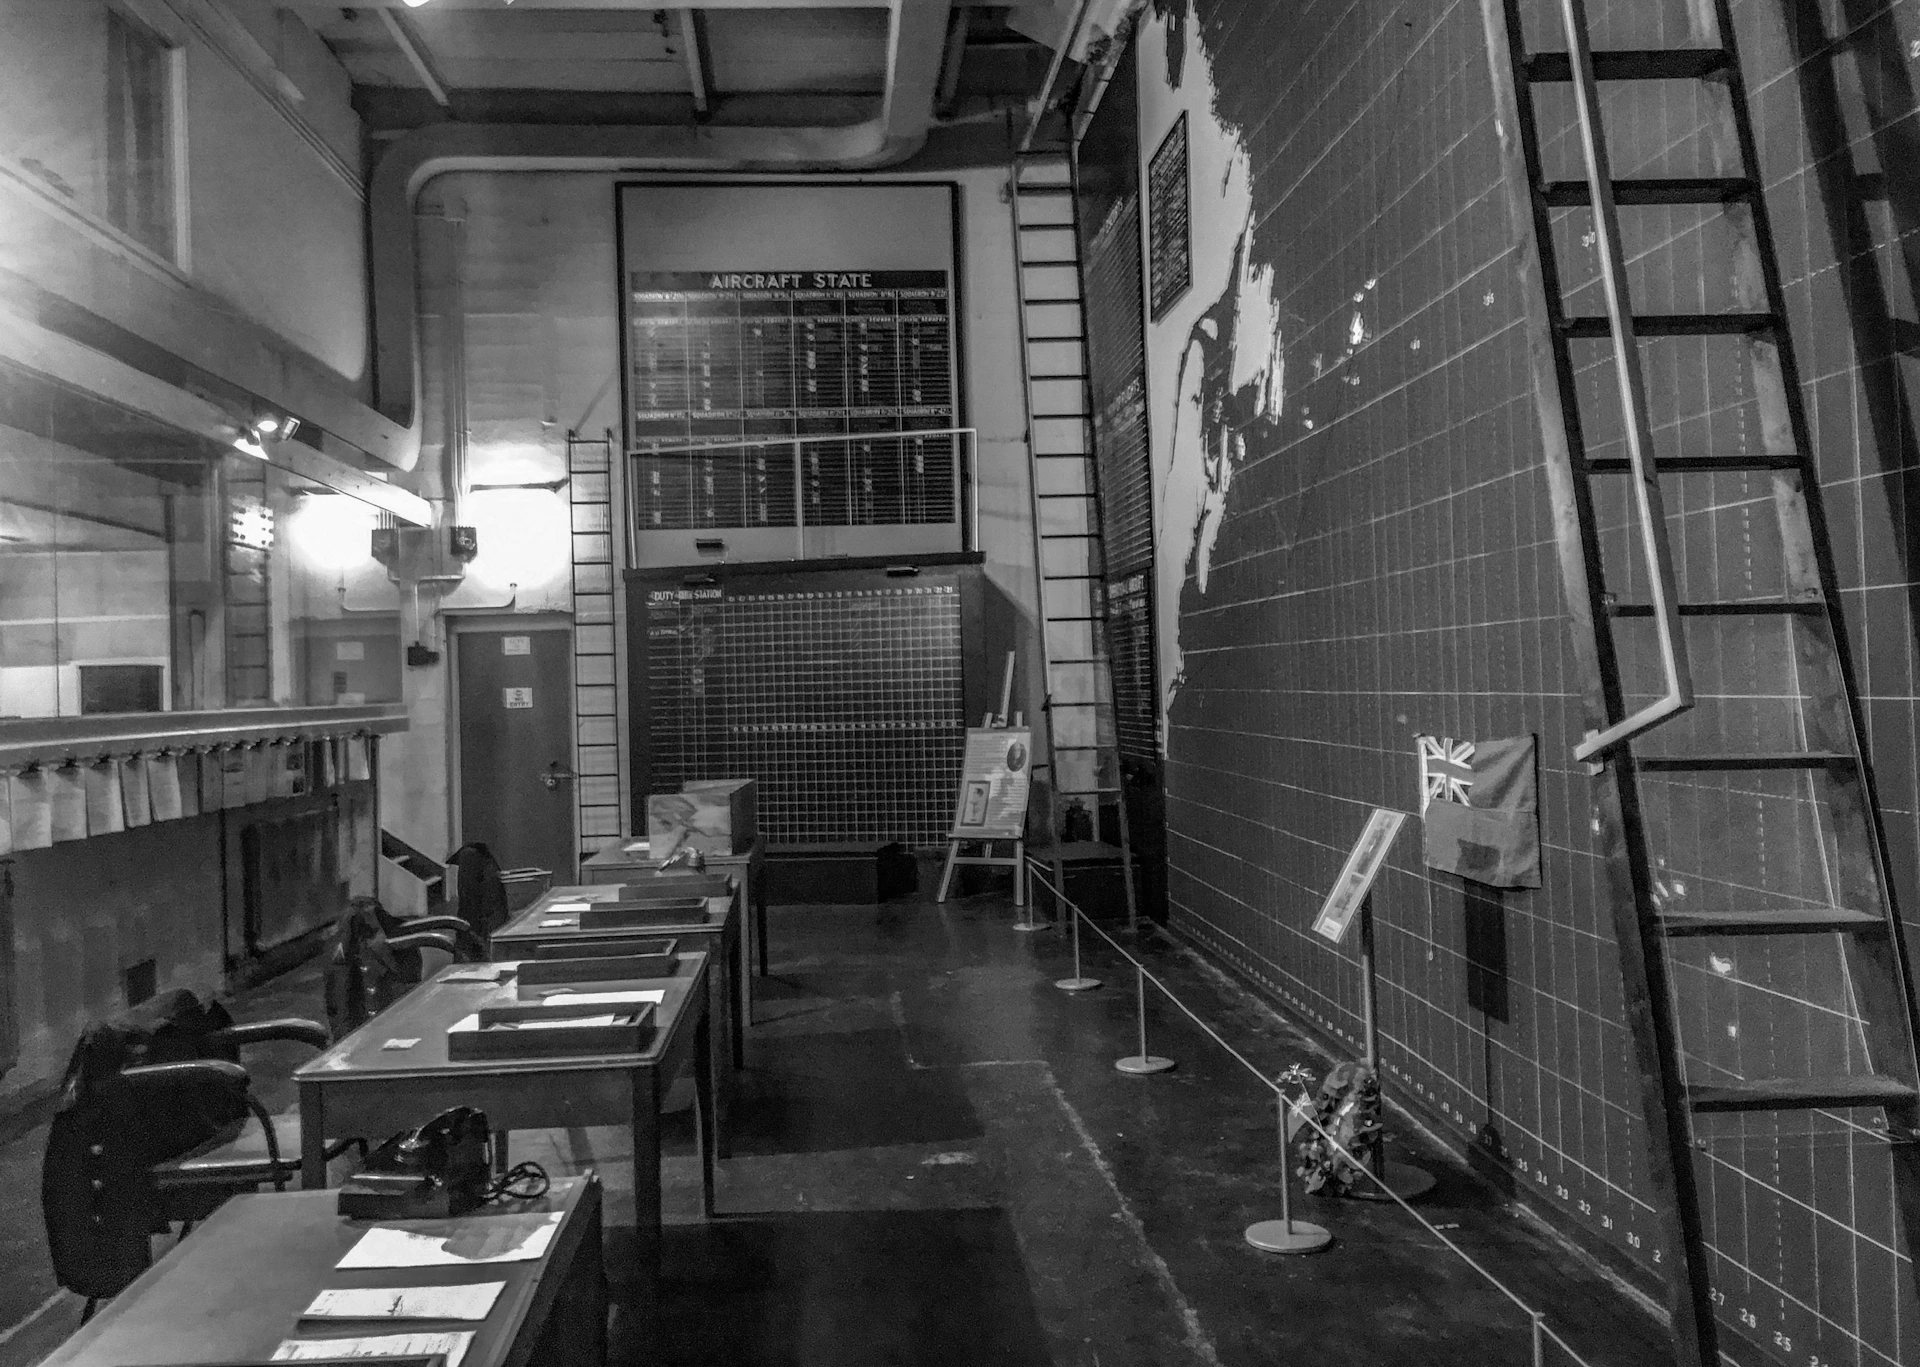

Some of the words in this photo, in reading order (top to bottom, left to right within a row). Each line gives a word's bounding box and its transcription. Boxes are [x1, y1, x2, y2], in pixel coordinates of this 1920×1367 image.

[710, 273, 803, 289] AIRCRAFT
[814, 272, 872, 289] STATE
[652, 590, 675, 601] DUTY
[693, 589, 722, 600] STATION
[1601, 1214, 1613, 1231] 31
[1626, 1231, 1641, 1249] 30
[1709, 1287, 1725, 1306] 27
[1773, 1331, 1792, 1352] 25
